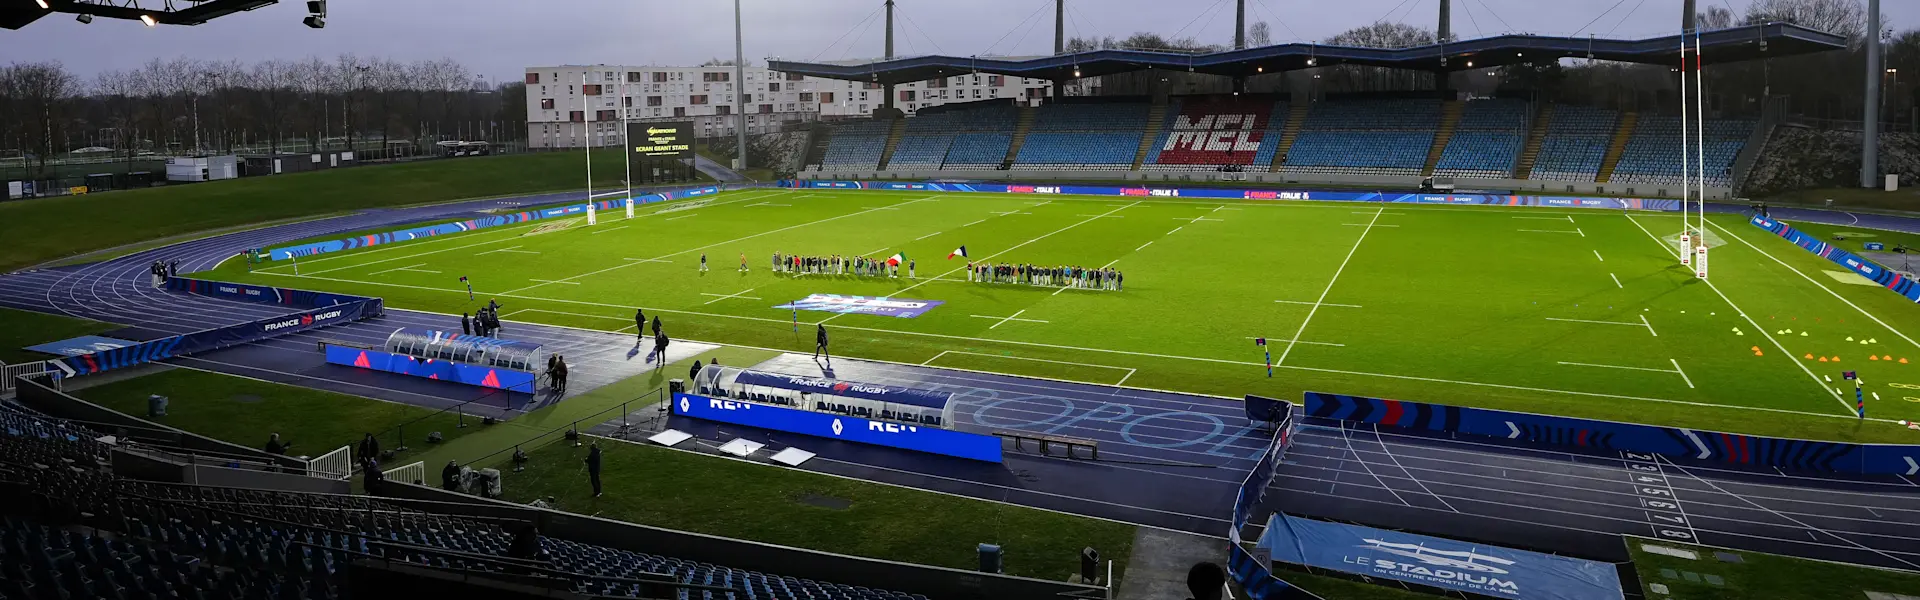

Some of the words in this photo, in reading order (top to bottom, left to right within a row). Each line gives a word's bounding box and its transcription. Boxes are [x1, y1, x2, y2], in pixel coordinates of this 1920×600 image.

[1163, 114, 1260, 151] MEL
[264, 319, 299, 331] FRANCE
[314, 310, 342, 322] RUGBY
[790, 377, 832, 389] FRANCE
[851, 385, 890, 395] RUGBY
[1660, 530, 1692, 538] 8
[1344, 555, 1371, 566] LE
[1375, 559, 1520, 590] STADIUM
[1390, 570, 1426, 582] CENTRE
[1427, 576, 1466, 587] SPORTIF
[1498, 588, 1520, 596] MEL
